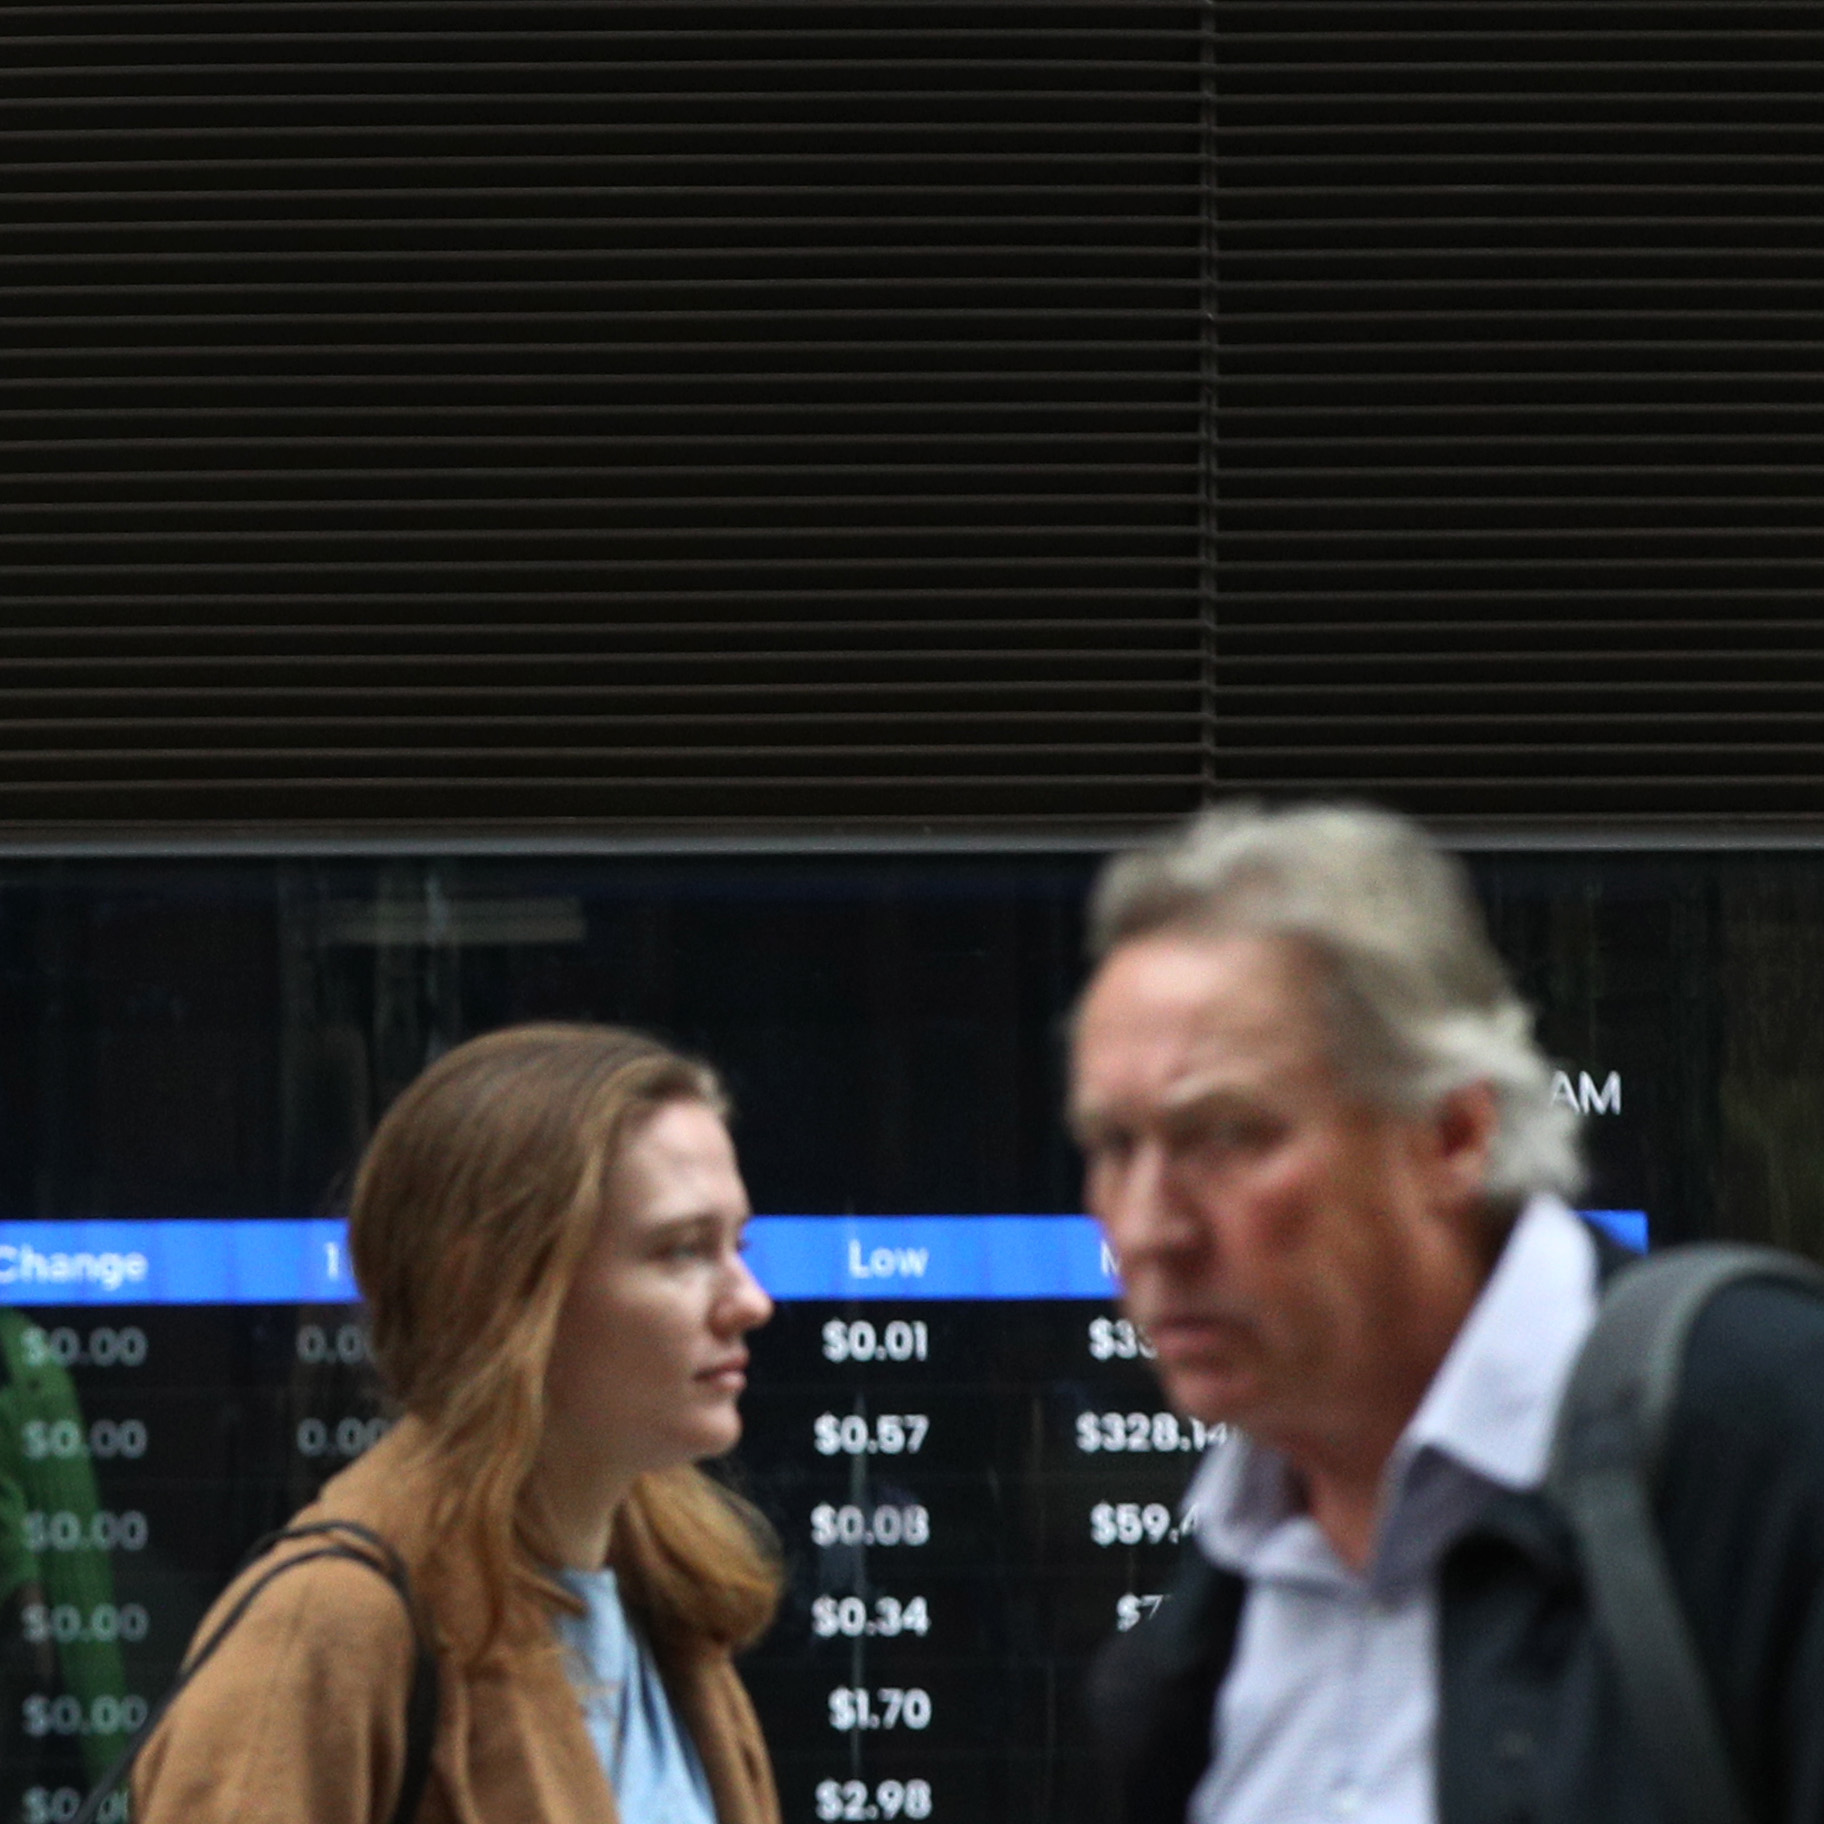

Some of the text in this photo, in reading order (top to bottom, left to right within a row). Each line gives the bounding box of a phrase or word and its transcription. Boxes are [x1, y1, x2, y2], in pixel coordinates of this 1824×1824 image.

[850, 1240, 929, 1279] Low
[22, 1327, 148, 1367] $0.00
[822, 1317, 929, 1361] $0.01
[22, 1420, 148, 1459] $0.00
[814, 1411, 930, 1456] $0.57
[22, 1511, 148, 1551] $0.00
[811, 1501, 930, 1547] $0.08
[22, 1603, 148, 1643] $0.00
[812, 1594, 931, 1638] $0.34
[828, 1686, 932, 1731] $1.70
[815, 1778, 933, 1823] $2.98
